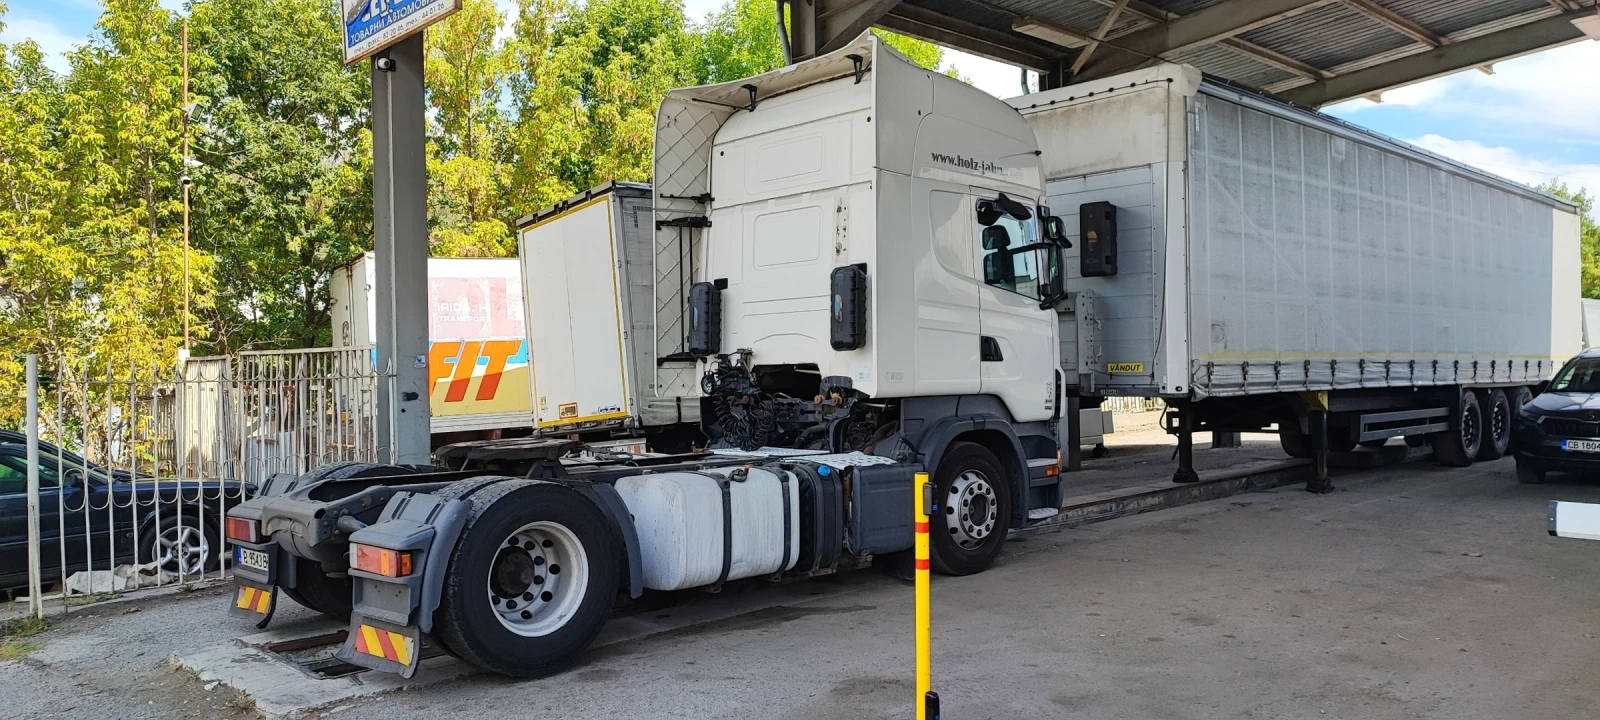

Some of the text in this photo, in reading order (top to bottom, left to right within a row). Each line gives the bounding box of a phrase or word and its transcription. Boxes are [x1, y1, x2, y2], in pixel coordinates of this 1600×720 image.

[351, 19, 385, 45] ТОВАРНИ
[387, 0, 431, 25] АВТОМОБ
[931, 152, 1024, 179] www.holz-jahn.
